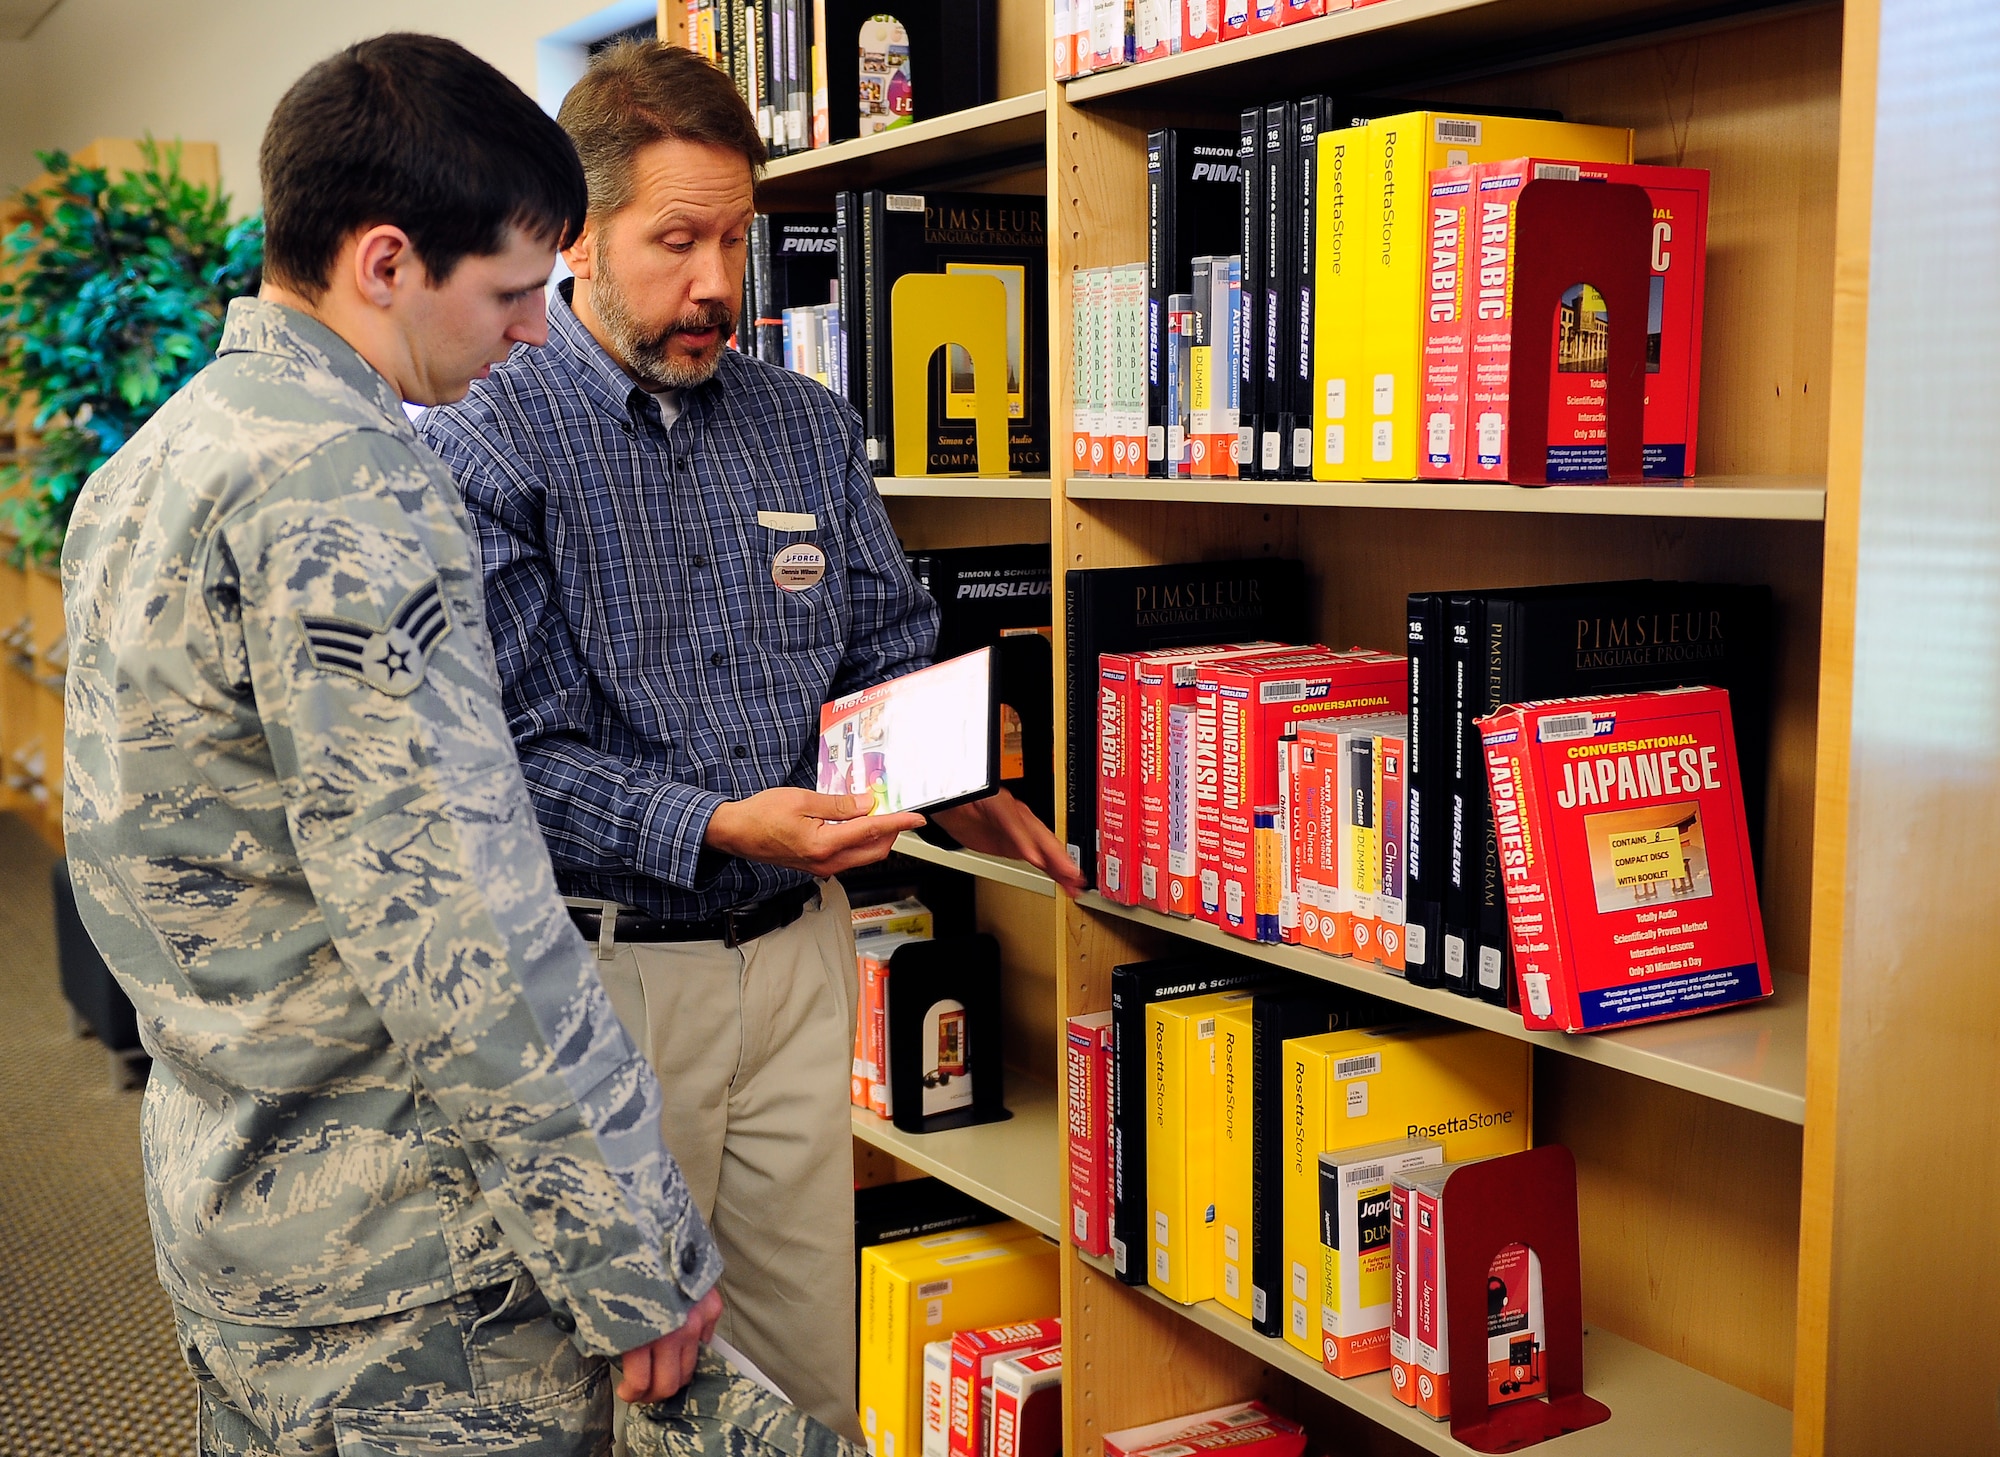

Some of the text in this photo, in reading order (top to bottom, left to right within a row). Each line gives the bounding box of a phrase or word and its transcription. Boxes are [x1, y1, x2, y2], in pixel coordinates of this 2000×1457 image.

[757, 37, 766, 99] PROGRAM
[1241, 135, 1253, 146] 16
[1267, 130, 1280, 141] 16
[1267, 140, 1281, 149] CDs
[1301, 123, 1313, 134] 16
[1301, 134, 1314, 142] CDs
[1148, 151, 1160, 162] 16
[1148, 161, 1161, 169] CDs
[1193, 146, 1234, 157] SIMON
[1241, 146, 1254, 155] CDs
[1382, 131, 1397, 267] RosettaStone
[1431, 185, 1469, 196] PIMSLEUR
[1480, 178, 1520, 191] PIMSLEUR
[924, 207, 1042, 232] PIMSLEUR
[1332, 144, 1346, 276] RosettaStone
[782, 238, 837, 252] PIMS
[924, 231, 1044, 245] LANGUAGE PROGRAM
[1430, 208, 1458, 322] ARABIC
[1455, 206, 1466, 322] CONVERSATIONAL
[1478, 202, 1509, 320] ARABIC
[1505, 200, 1516, 320] CONVERSATIONAL
[864, 206, 874, 408] PIMSLEUR LANGUAGE PROGRAM
[1150, 302, 1159, 385] PIMSLEUR
[1195, 311, 1203, 344] Arabic
[1242, 293, 1252, 381] PIMSLEUR
[1267, 293, 1277, 380] PIMSLEUR
[1300, 290, 1310, 378] PIMSLEUR
[1195, 355, 1203, 407] DUMMIES
[1231, 358, 1239, 409] Guaranteed
[1566, 396, 1604, 406] Scientifically
[938, 436, 974, 446] Simon &
[1010, 435, 1033, 445] Audio
[1574, 430, 1597, 440] Only 30
[930, 453, 977, 466] COMPA
[1008, 452, 1041, 465] ISCS
[957, 570, 992, 579] SIMON
[1136, 580, 1261, 610] PIMSLEUR
[1067, 590, 1076, 654] PIMSLEUR
[1136, 604, 1263, 627] LANGUAGE PROGRAM
[1409, 622, 1422, 632] 16
[1454, 625, 1466, 636] 16
[1576, 610, 1725, 650] PIMSLEUR
[1409, 632, 1423, 641] CDs
[1453, 635, 1468, 644] CDs
[1490, 623, 1502, 709] PIMSLEUR
[1576, 643, 1725, 670] LANGUAGE PROGRAM
[1067, 657, 1076, 738] LANGUAGE
[1292, 696, 1390, 714] CONVERSATIONAL
[1101, 687, 1117, 778] ARABIC
[1196, 693, 1217, 801] TURKISH
[1567, 734, 1697, 758] CONVERSATIONAL
[1222, 699, 1239, 810] HUNGARIAN
[1238, 709, 1246, 805] CONVERSATIONAL
[1557, 746, 1721, 809] JAPANESE
[1324, 768, 1334, 873] Learn Anywhere!
[1356, 788, 1364, 825] Chinese
[1487, 750, 1529, 881] JAPANESE
[1510, 757, 1535, 868] CONVERSATIONAL
[1306, 787, 1317, 865] Rapid Chinese
[1409, 788, 1420, 880] PIMSLEUR
[1452, 794, 1463, 889] PIMSLEUR
[1612, 836, 1647, 848] CONTAINS
[1356, 835, 1365, 891] DUMMIES
[1385, 800, 1397, 896] Rapid Chinese
[1485, 813, 1498, 906] PROGRAM
[1615, 851, 1670, 867] COMPACT DISCS
[1618, 870, 1669, 886] WITH BOOKLET
[1613, 921, 1708, 944] Scientifically Proven Method
[1636, 909, 1678, 924] Totally Audio
[1629, 966, 1644, 977] Only
[1645, 964, 1655, 975] 30
[1655, 959, 1682, 973] Minutes
[1688, 957, 1702, 968] Day
[1630, 941, 1694, 959] Interactive Lessons
[1155, 982, 1207, 996] SIMON &
[1254, 1019, 1263, 1089] PIMSLEUR
[1068, 1047, 1080, 1138] CHINESE
[1155, 1021, 1165, 1127] RosettaStone
[1225, 1032, 1235, 1141] RosettaStone
[1078, 1054, 1087, 1137] MANDARIN
[1294, 1061, 1305, 1175] RosettaStone
[1407, 1110, 1515, 1139] RosettaStone
[879, 1228, 911, 1240] SIMON
[1324, 1210, 1332, 1247] Japanese
[1367, 1254, 1391, 1264] Referenc
[1324, 1252, 1333, 1308] DUMMIES
[1396, 1264, 1406, 1318] Japanese
[1423, 1280, 1434, 1332] Japanese
[987, 1323, 1043, 1342] DARI
[929, 1380, 942, 1433] DARI
[954, 1376, 969, 1438] DARI
[997, 1407, 1015, 1457] IRIS
[1192, 1425, 1275, 1448] KOREAN
